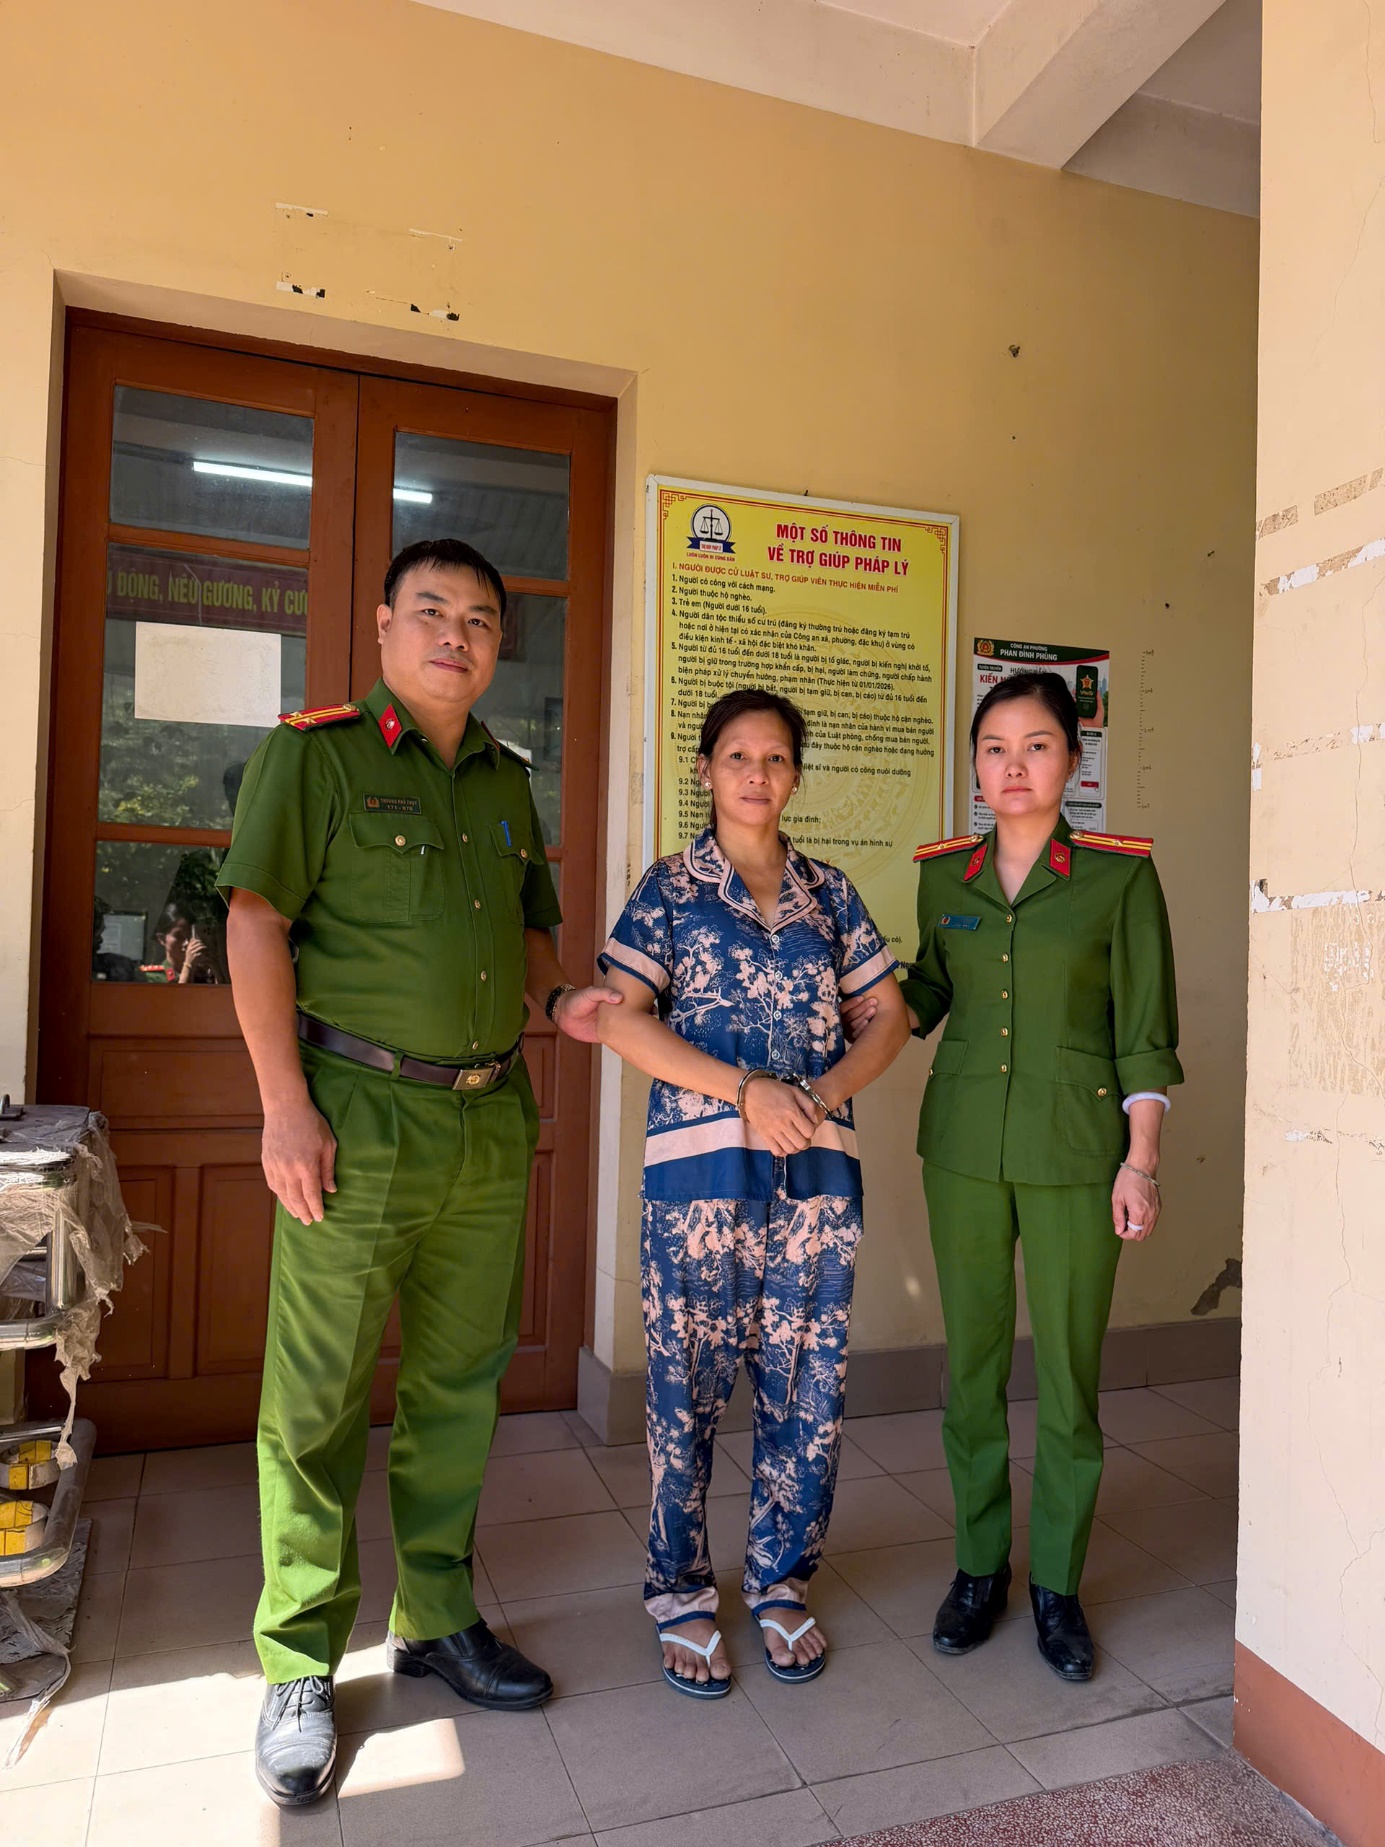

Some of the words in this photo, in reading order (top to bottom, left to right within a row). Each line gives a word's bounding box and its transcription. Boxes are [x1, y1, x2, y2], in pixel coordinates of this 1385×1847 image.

[776, 522, 805, 543] MỘT
[810, 525, 829, 544] SỐ
[833, 530, 876, 550] THÔNG
[880, 536, 902, 552] TIN
[768, 543, 784, 562] VỀ
[789, 548, 815, 568] TRỢ
[819, 551, 850, 569] GIÚP
[854, 556, 890, 573] PHÁP
[894, 559, 909, 576] LÝ
[202, 580, 257, 613] GƯƠNG,
[262, 581, 281, 613] KỶ
[1000, 649, 1018, 657] PHAN
[1018, 650, 1035, 659] ĐÌNH
[1035, 652, 1058, 661] PHÙNG
[980, 673, 998, 684] KIẾN
